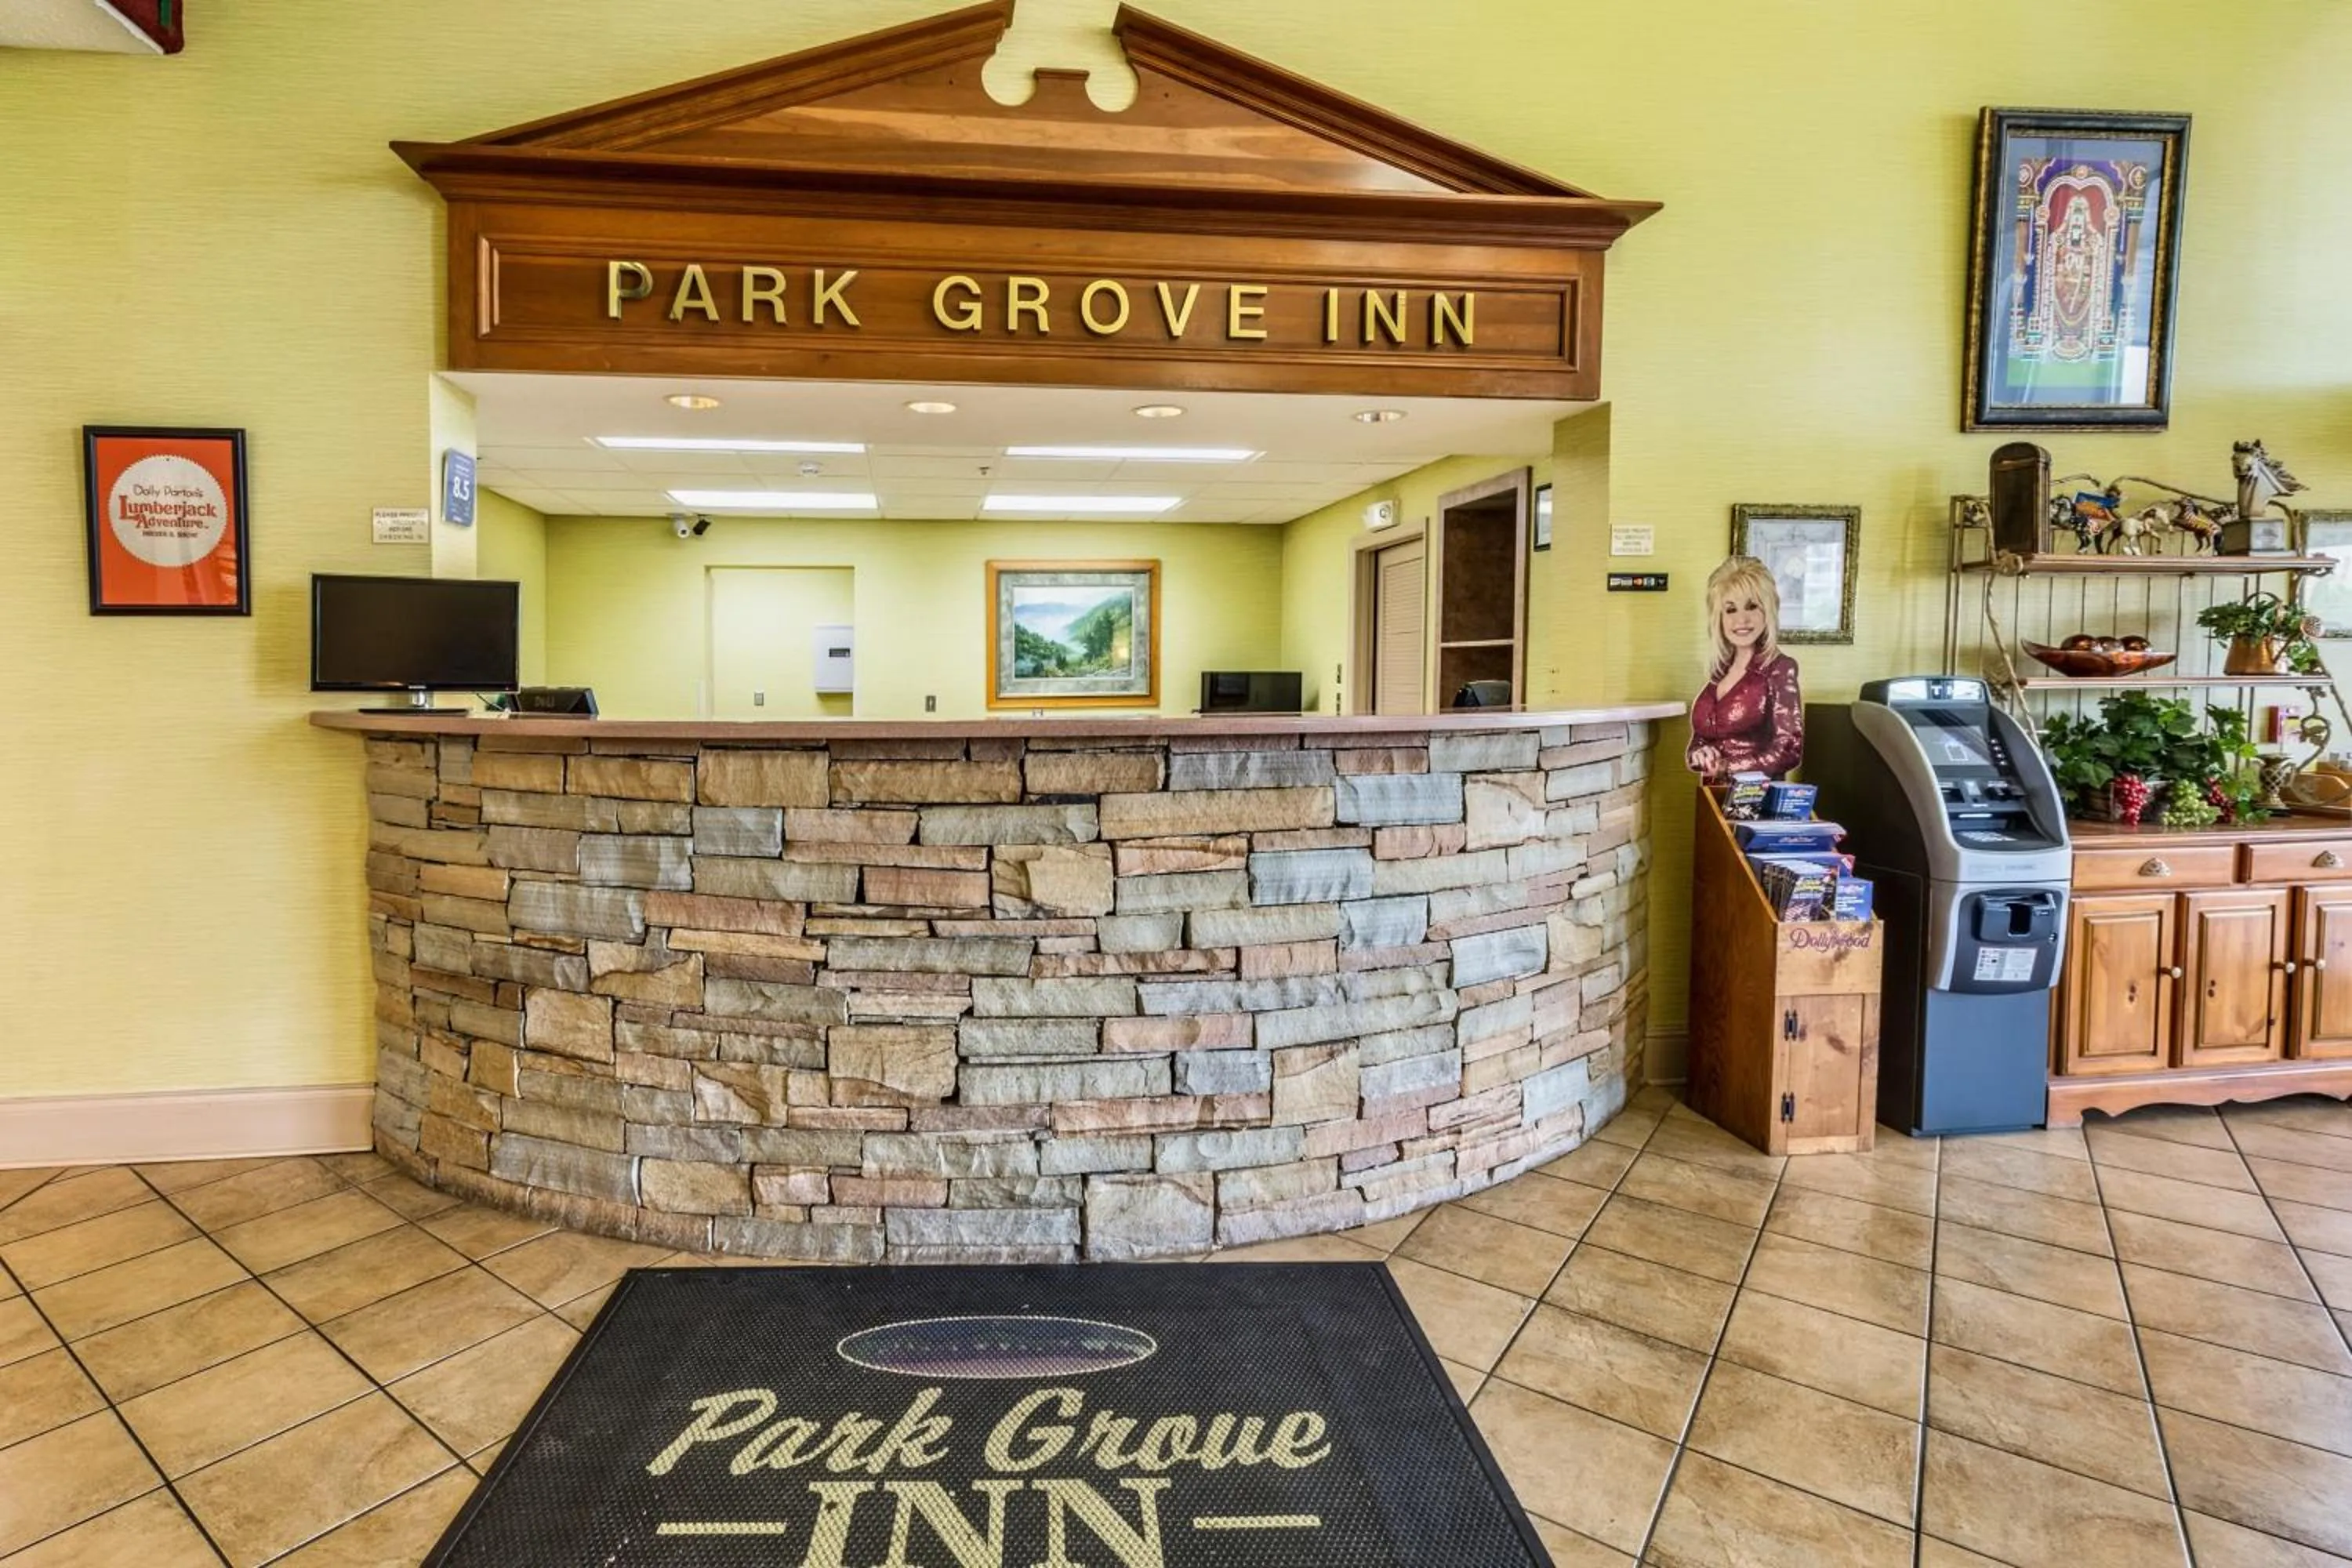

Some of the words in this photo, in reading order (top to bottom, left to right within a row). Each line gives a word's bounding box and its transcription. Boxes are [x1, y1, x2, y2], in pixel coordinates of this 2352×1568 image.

[608, 260, 862, 327] PARK
[932, 274, 1269, 339] GROVE
[1326, 287, 1475, 346] INN
[132, 483, 161, 498] Dolly
[163, 485, 205, 498] Parton's
[453, 475, 470, 502] 8.5
[118, 494, 218, 521] Lumberjack
[135, 514, 204, 530] Adventure
[1790, 927, 1871, 954] Dollywood
[645, 1386, 953, 1475] Park
[984, 1386, 1332, 1472] Grove
[798, 1477, 1172, 1568] INN
